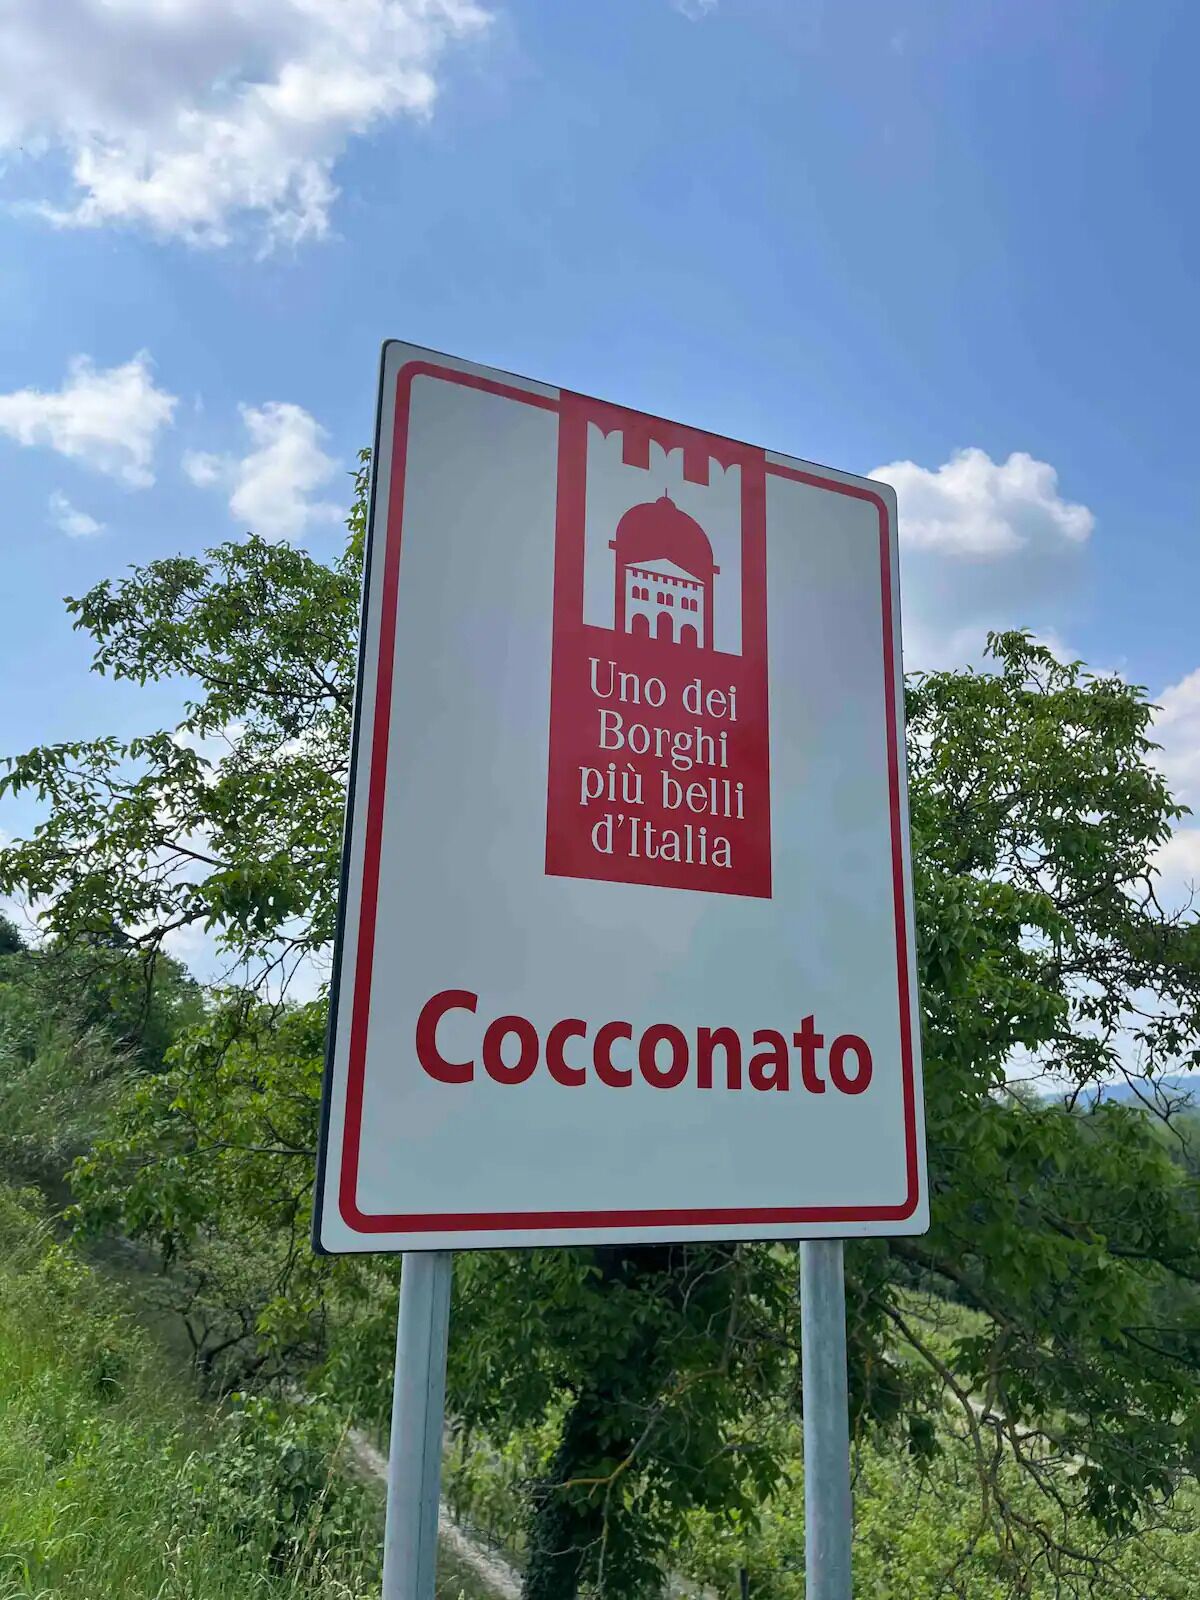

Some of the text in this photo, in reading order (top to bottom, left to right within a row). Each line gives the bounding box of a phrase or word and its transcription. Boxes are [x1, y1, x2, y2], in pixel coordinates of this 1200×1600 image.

[588, 656, 737, 722] Uno dei
[597, 708, 729, 772] Borghi
[578, 762, 745, 820] più belli
[591, 813, 733, 869] d'Italia
[416, 990, 872, 1094] Cocconato
